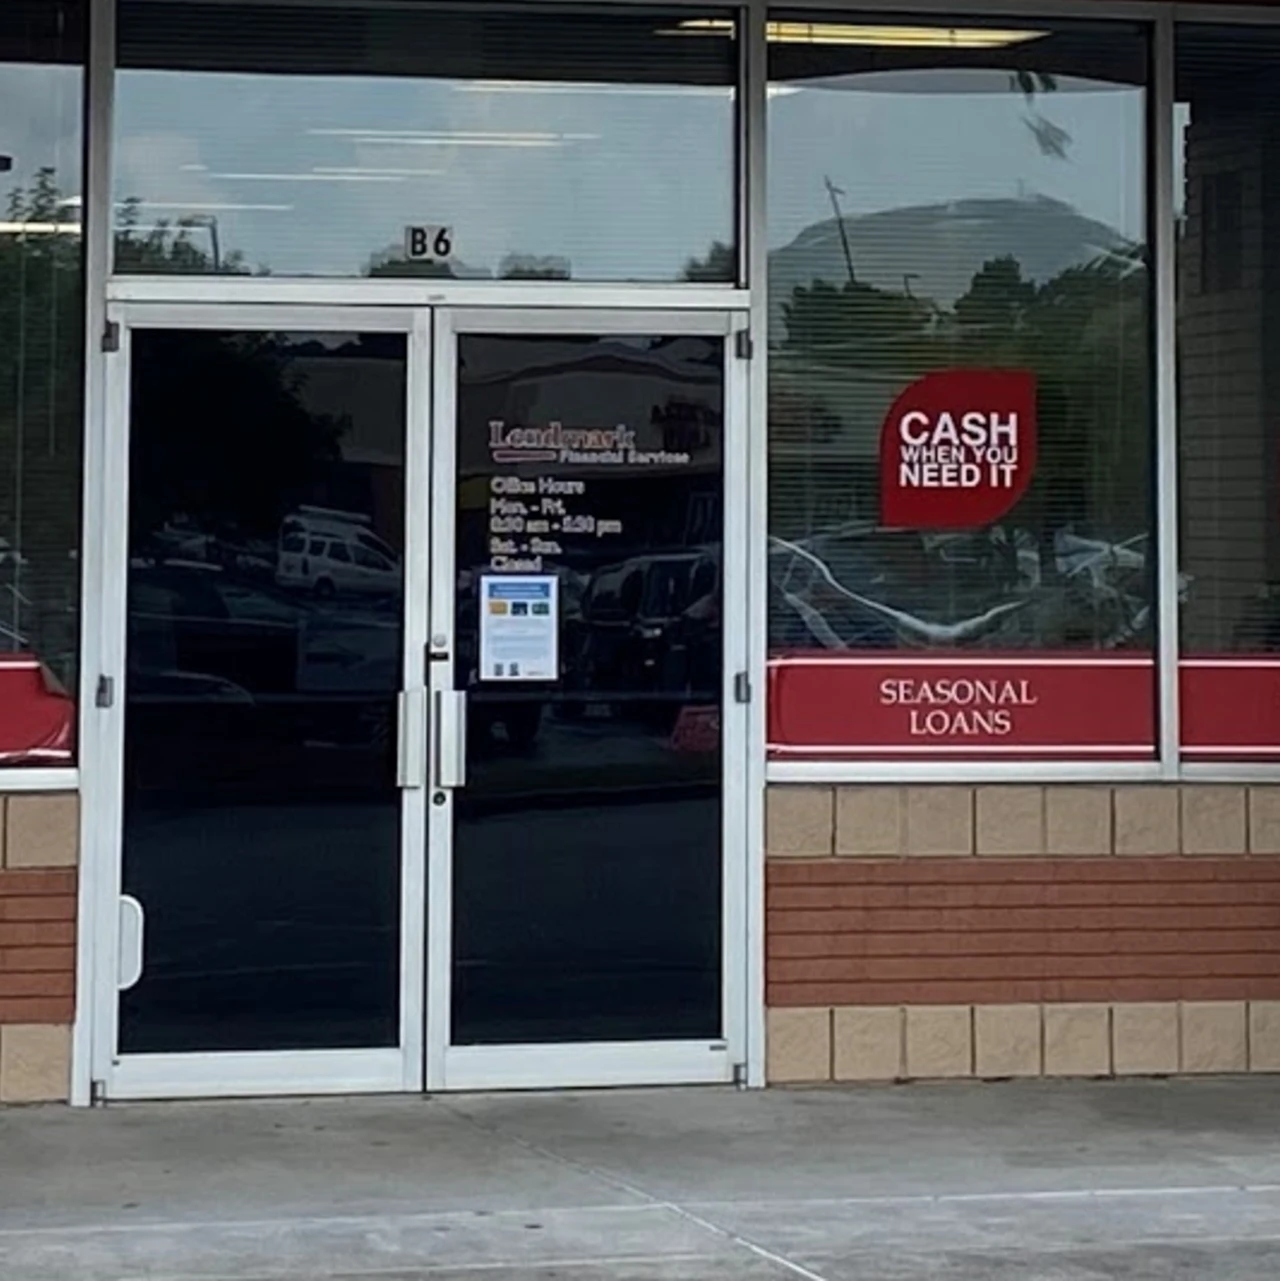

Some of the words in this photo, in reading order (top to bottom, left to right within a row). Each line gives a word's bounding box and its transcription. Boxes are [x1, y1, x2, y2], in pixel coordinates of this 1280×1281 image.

[411, 227, 452, 257] B6
[488, 421, 636, 450] Lendmark
[898, 411, 1018, 446] CASH
[899, 444, 966, 464] WHEN
[971, 446, 1018, 464] YOU
[898, 463, 982, 488] NEED
[989, 464, 1018, 488] IT
[879, 678, 1038, 705] SEASONAL
[909, 709, 1012, 736] LOANS
